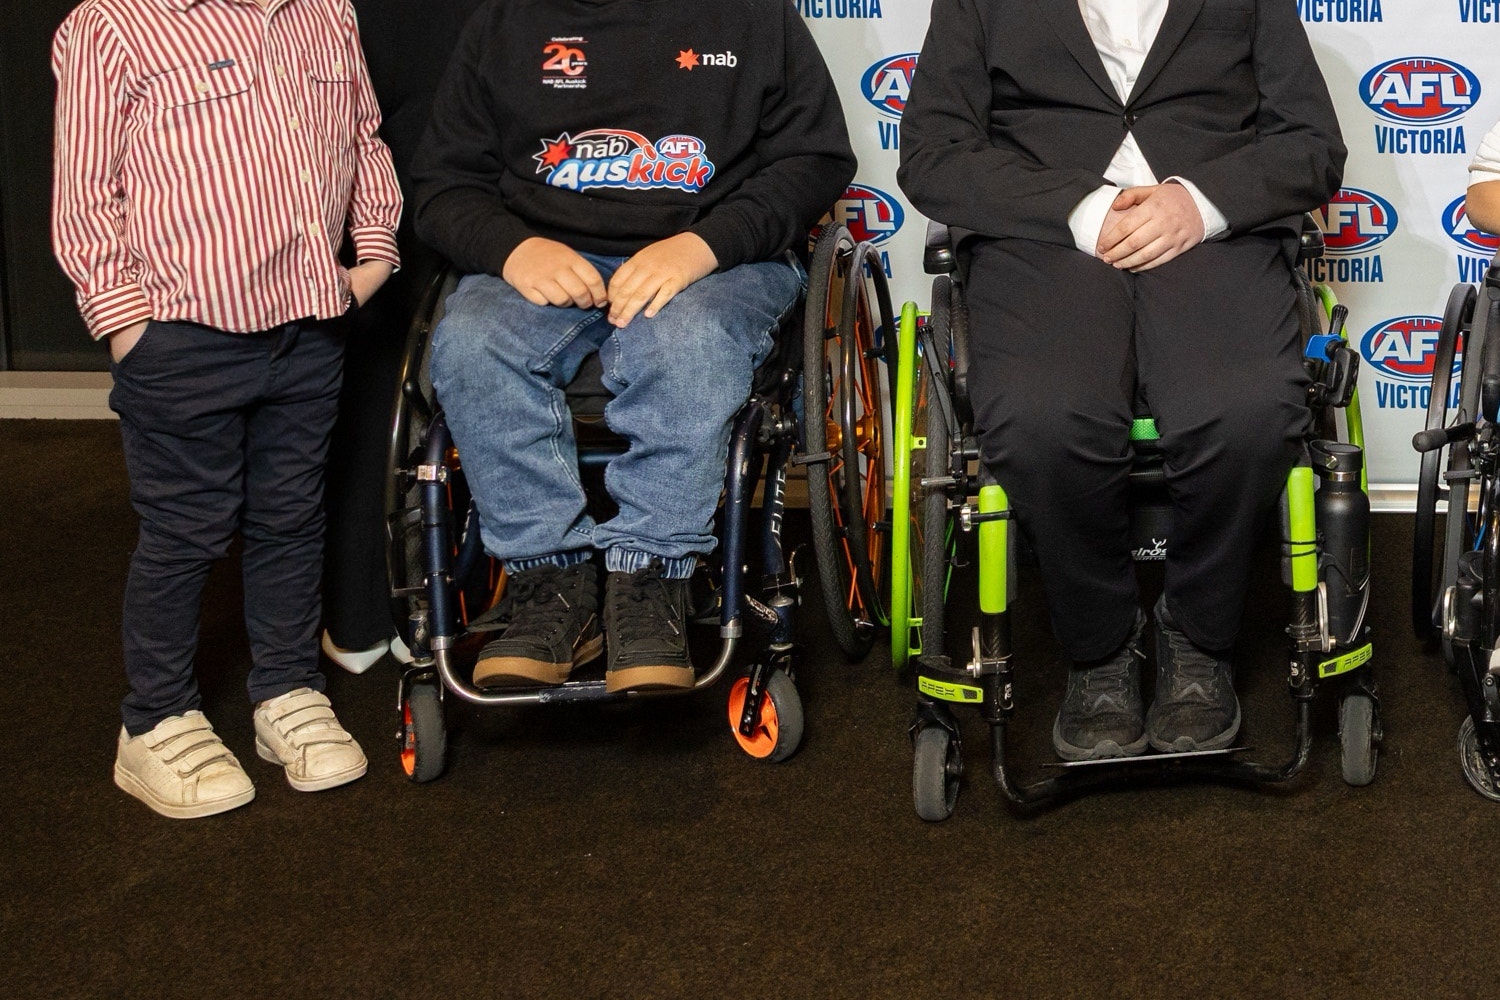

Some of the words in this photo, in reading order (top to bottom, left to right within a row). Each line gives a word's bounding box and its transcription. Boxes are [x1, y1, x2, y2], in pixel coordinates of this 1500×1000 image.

[702, 50, 737, 68] nab
[1370, 73, 1472, 105] AFL
[575, 138, 625, 159] nab
[660, 141, 700, 155] AFL
[1375, 125, 1466, 154] VICTORIA
[834, 199, 896, 232] FL
[1370, 331, 1462, 362] AF
